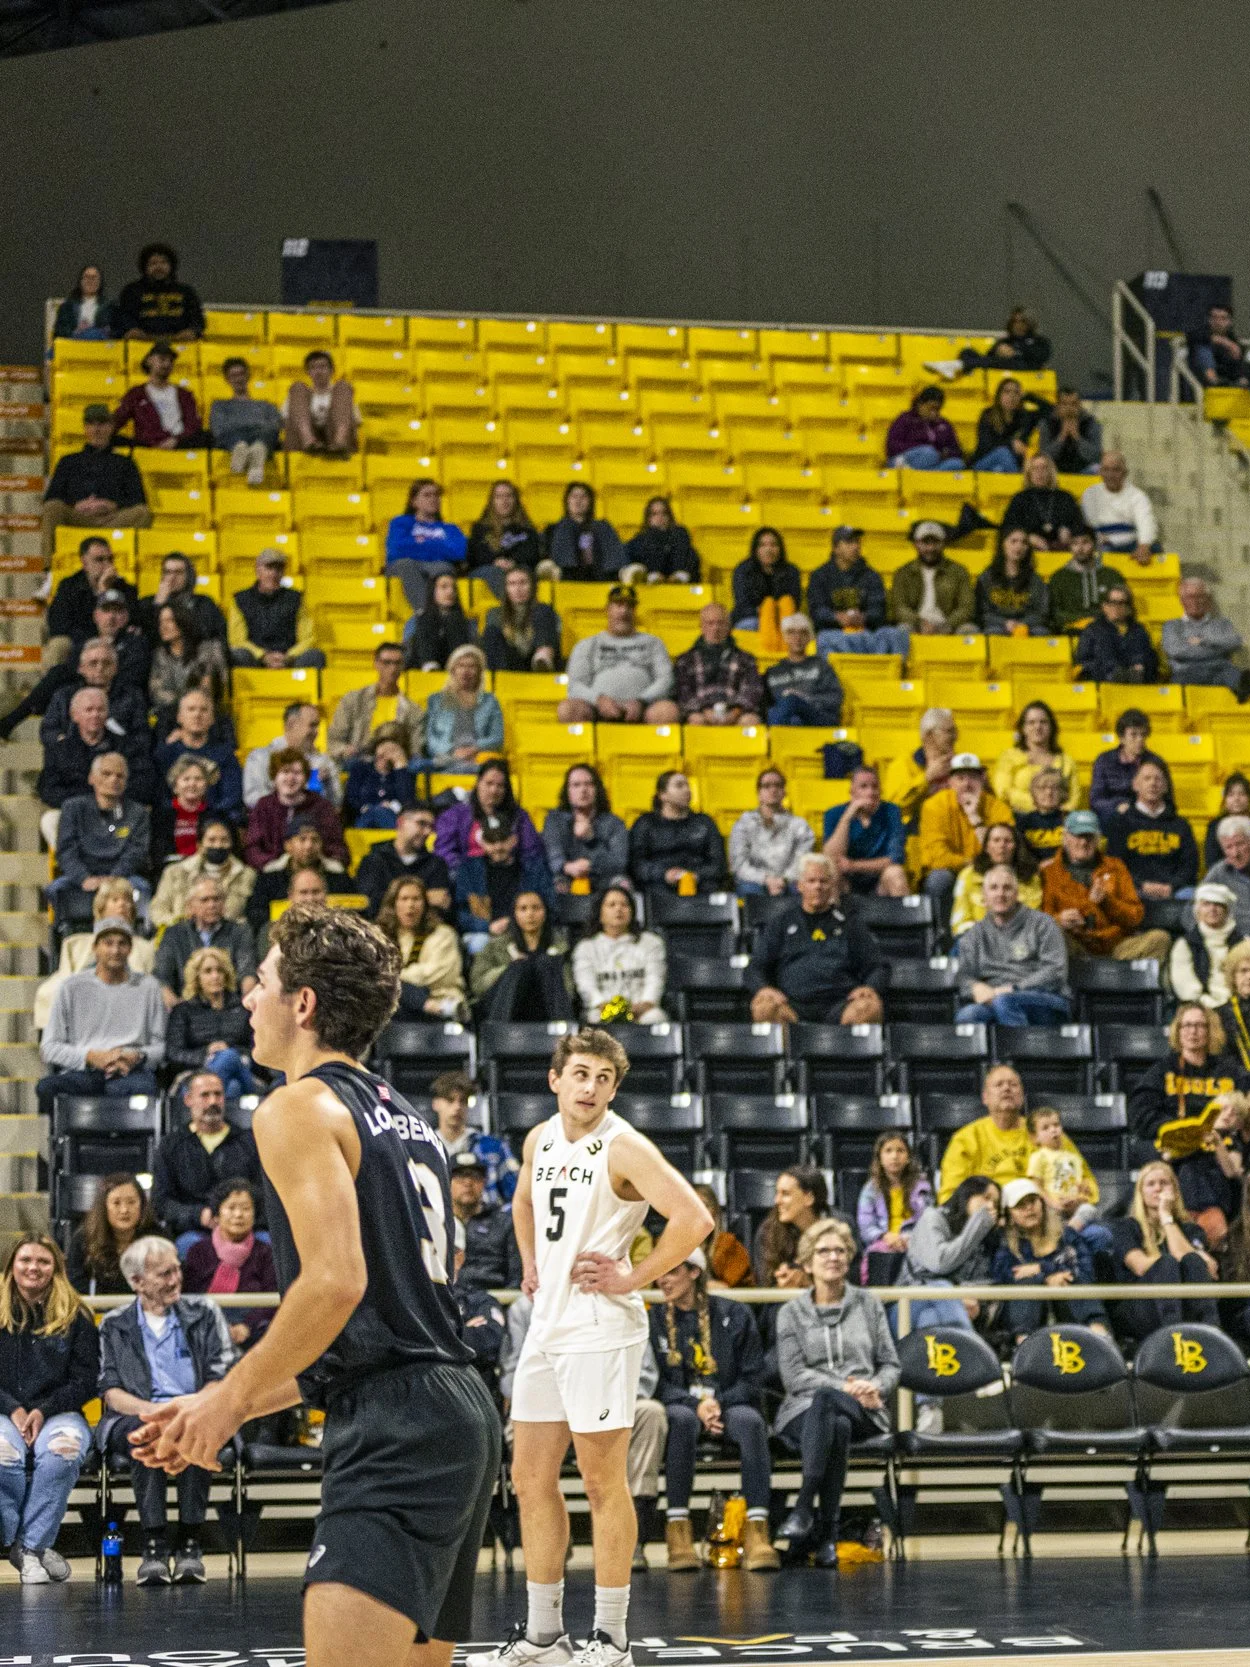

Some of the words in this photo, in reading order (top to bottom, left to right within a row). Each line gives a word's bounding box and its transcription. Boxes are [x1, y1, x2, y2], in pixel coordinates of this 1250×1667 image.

[364, 1105, 396, 1137] LO
[393, 1114, 447, 1165] BEA
[536, 1166, 593, 1185] BEACH
[546, 1188, 568, 1242] 5
[646, 1635, 1084, 1657] BRUCE
